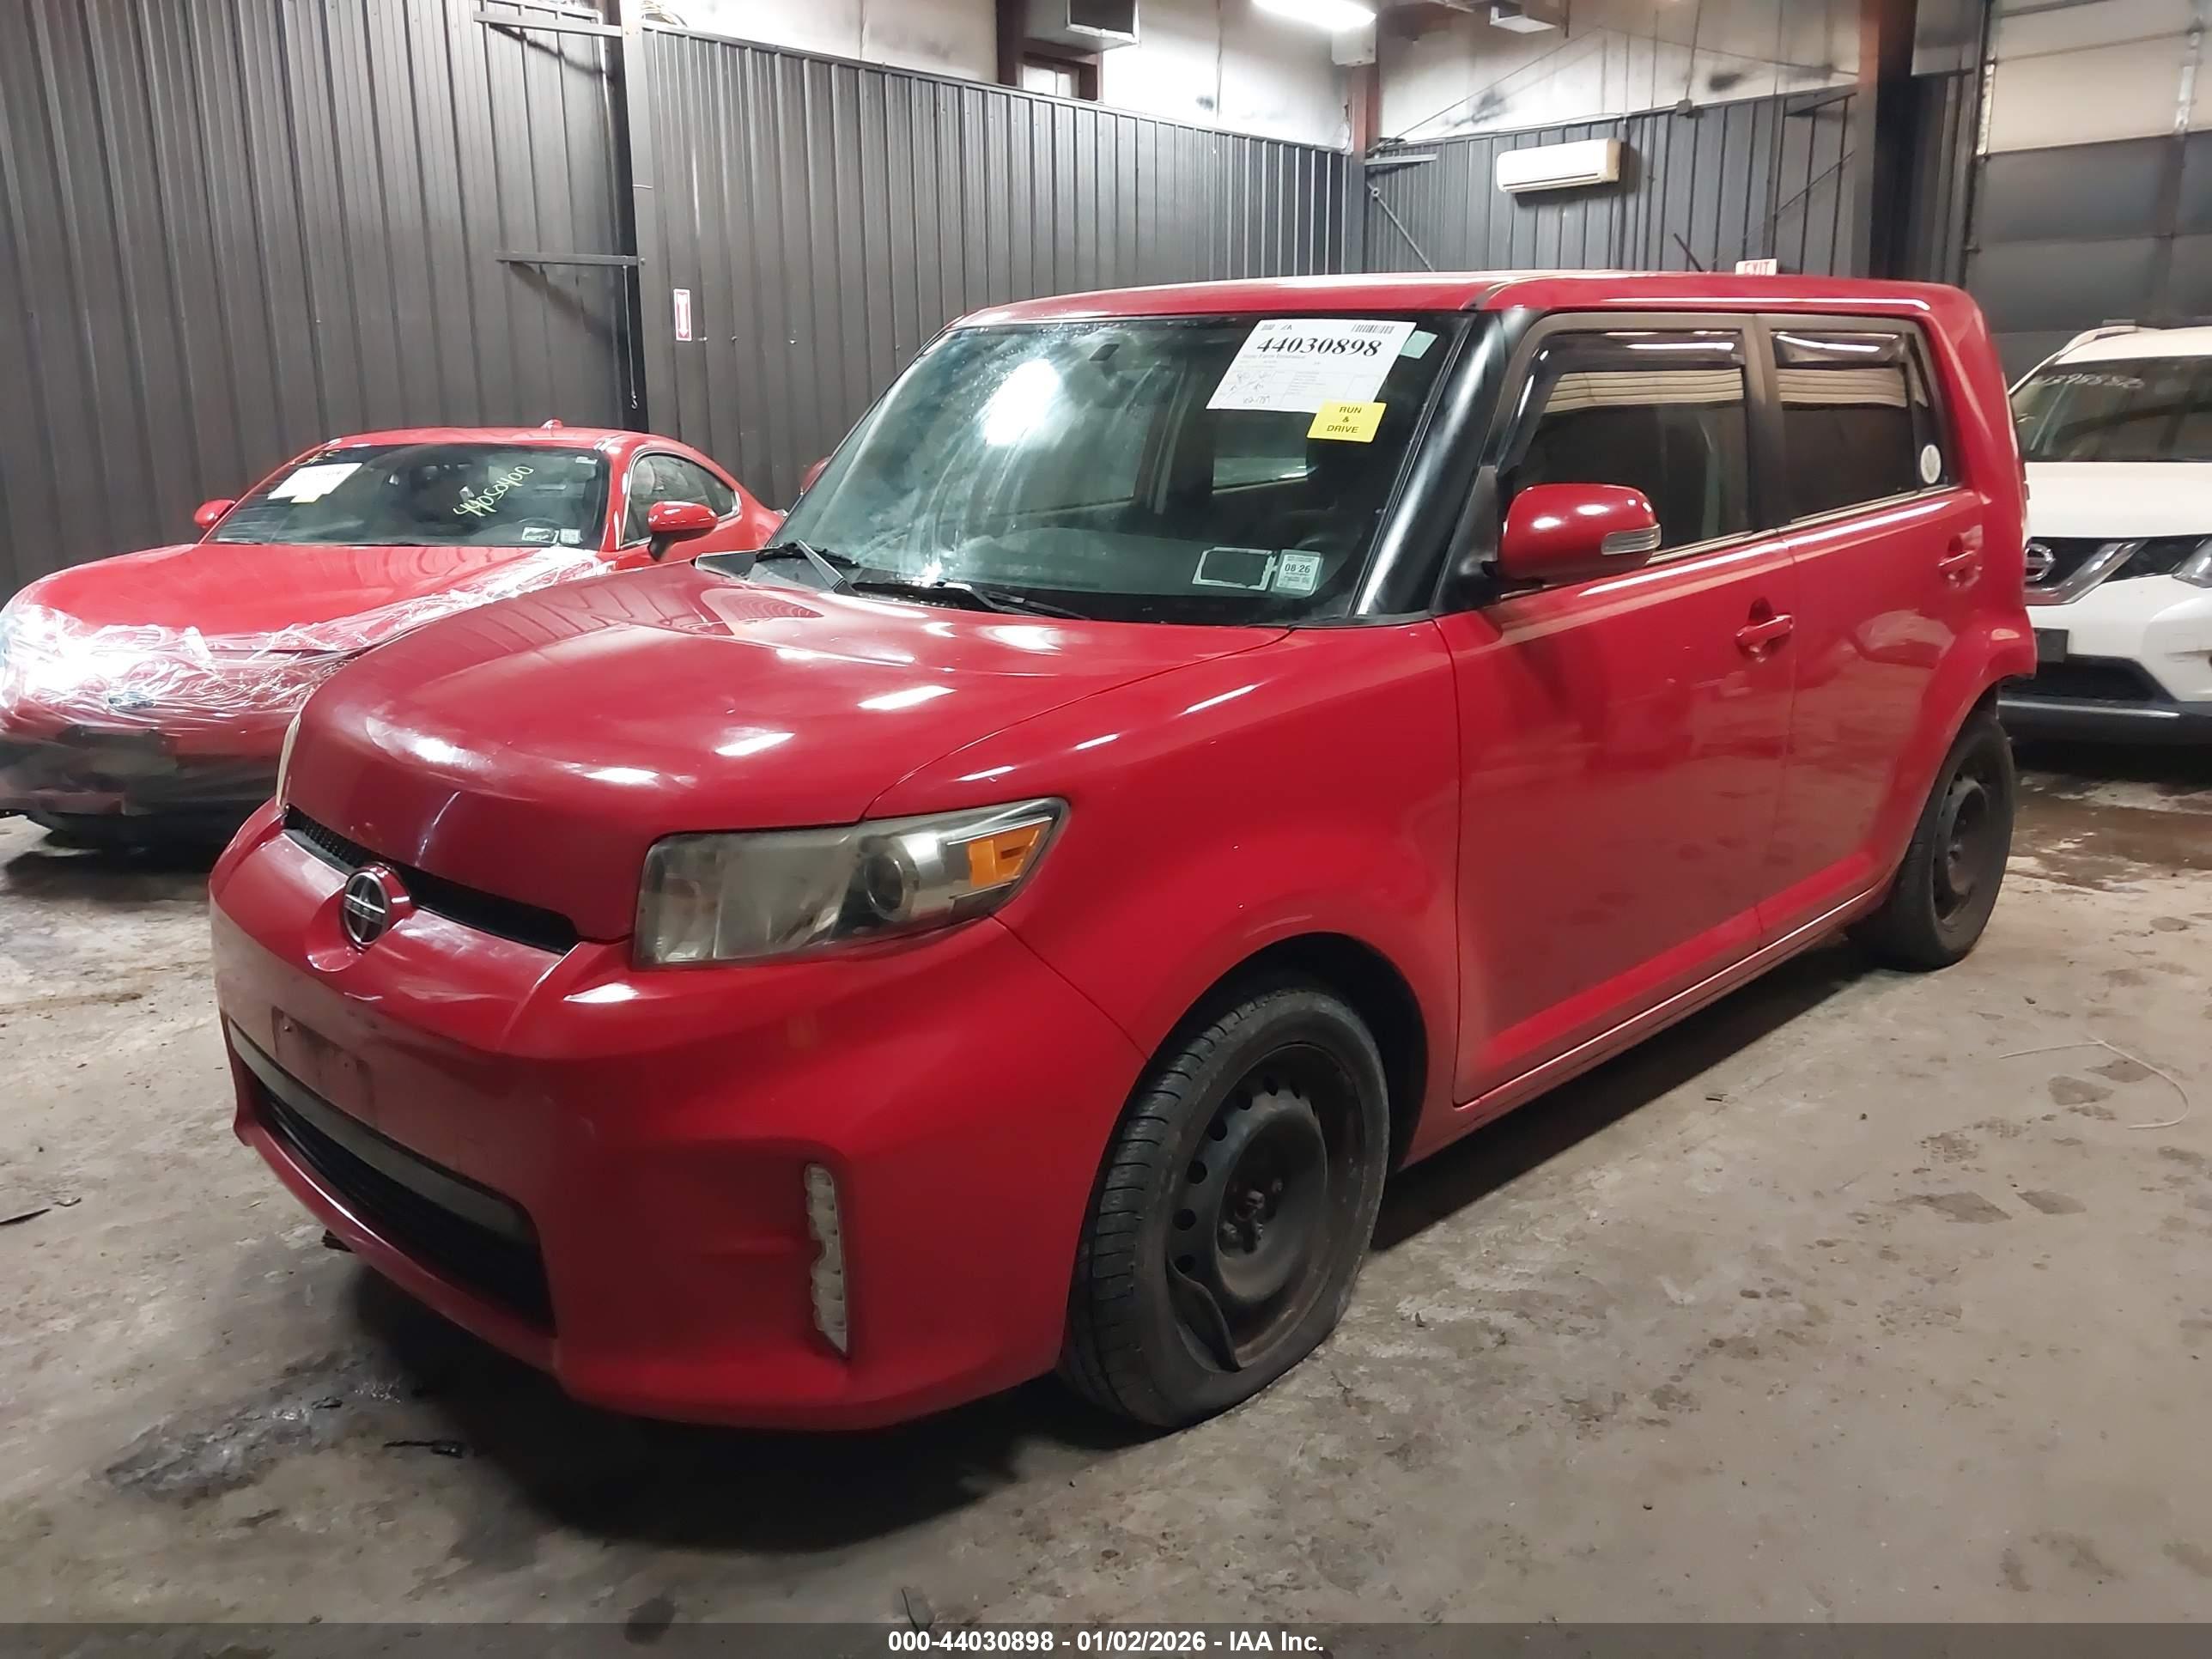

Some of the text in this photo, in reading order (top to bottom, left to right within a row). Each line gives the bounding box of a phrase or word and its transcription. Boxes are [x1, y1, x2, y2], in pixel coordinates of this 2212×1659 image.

[1257, 337, 1382, 357] 44030898
[1327, 425, 1359, 434] DRIVE
[1298, 564, 1310, 574] 26
